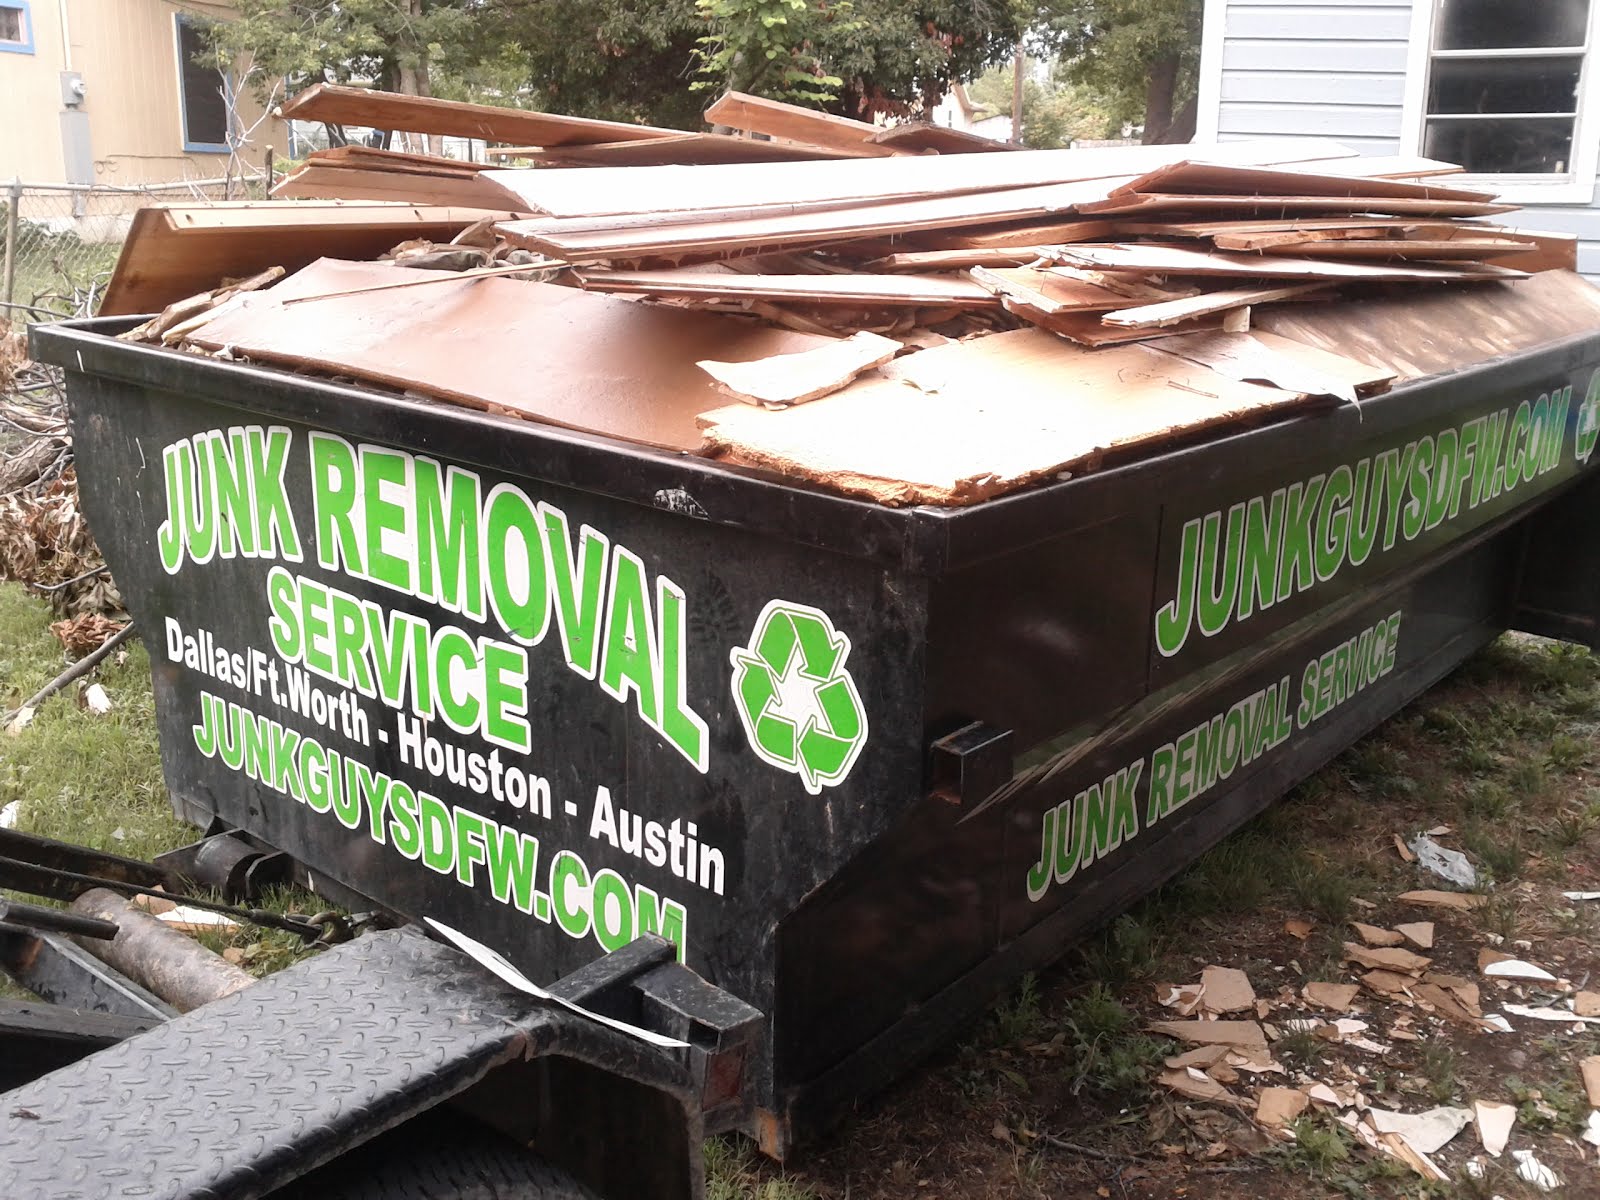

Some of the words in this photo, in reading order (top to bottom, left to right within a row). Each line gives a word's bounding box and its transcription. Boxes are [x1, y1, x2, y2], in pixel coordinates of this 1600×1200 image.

[158, 426, 303, 575] JUNK
[308, 430, 710, 774] REMOVAL
[267, 565, 532, 755] SERVICE
[1155, 386, 1572, 657] JUNKGUYSDFW.COM
[165, 616, 370, 746] Dallas/Ft.Worth
[397, 712, 552, 820] Houston
[589, 786, 726, 896] Austin
[1026, 757, 1142, 902] JUNK
[1146, 675, 1292, 827] REMOVAL
[1297, 610, 1401, 730] SERVICE
